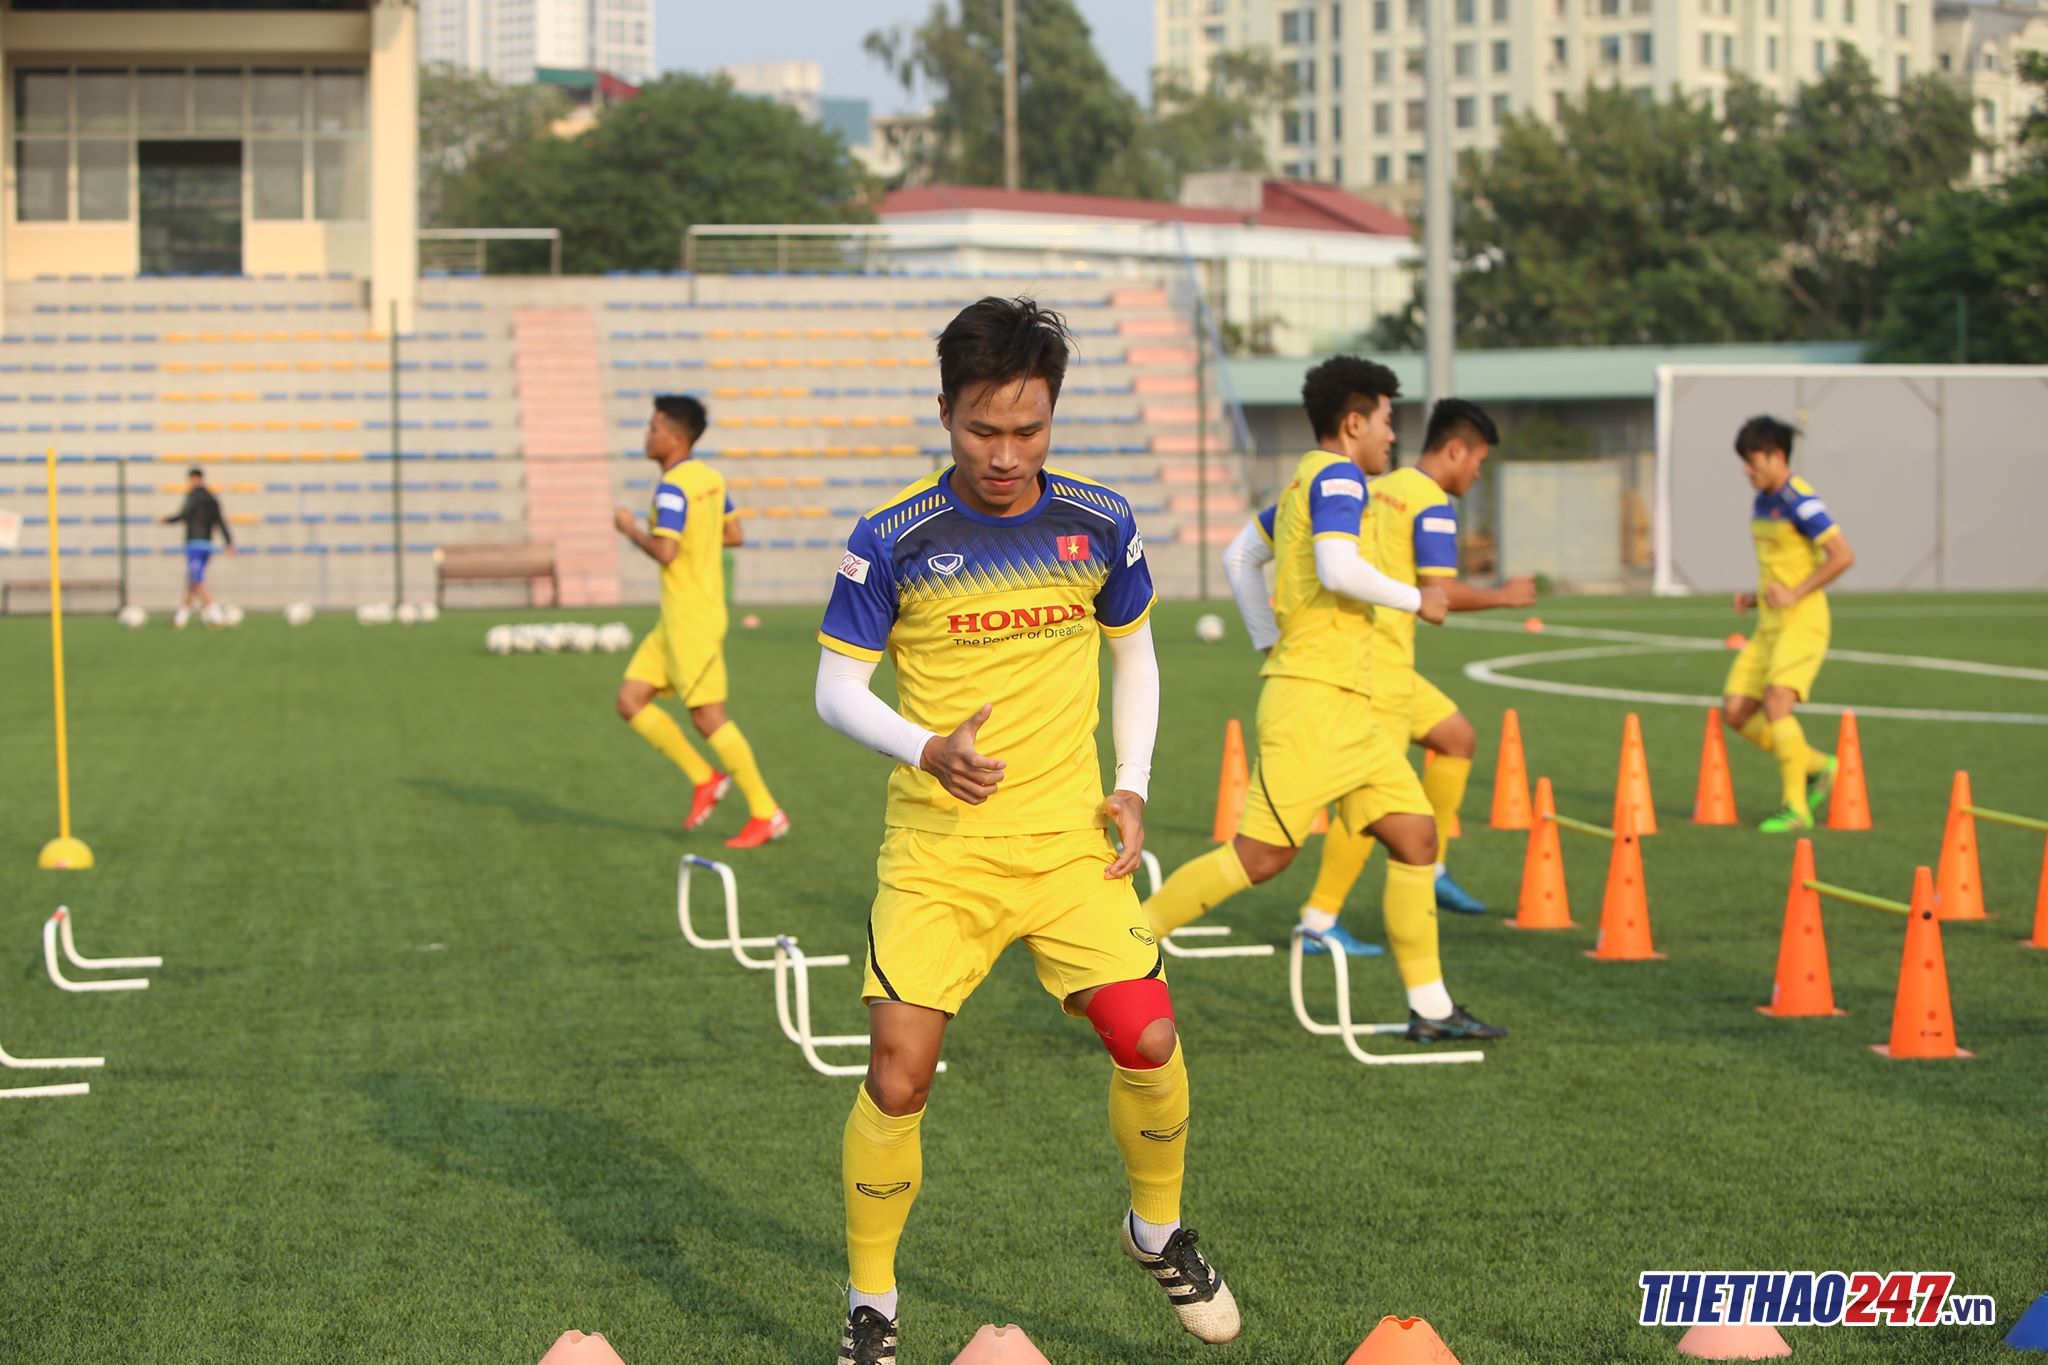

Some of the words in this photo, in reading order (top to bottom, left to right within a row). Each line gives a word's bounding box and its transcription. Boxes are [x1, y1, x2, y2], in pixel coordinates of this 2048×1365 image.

[947, 604, 1086, 633] HONDA
[953, 638, 980, 647] The
[983, 632, 1025, 646] Power
[1027, 630, 1042, 639] of
[1044, 623, 1084, 639] Dreams
